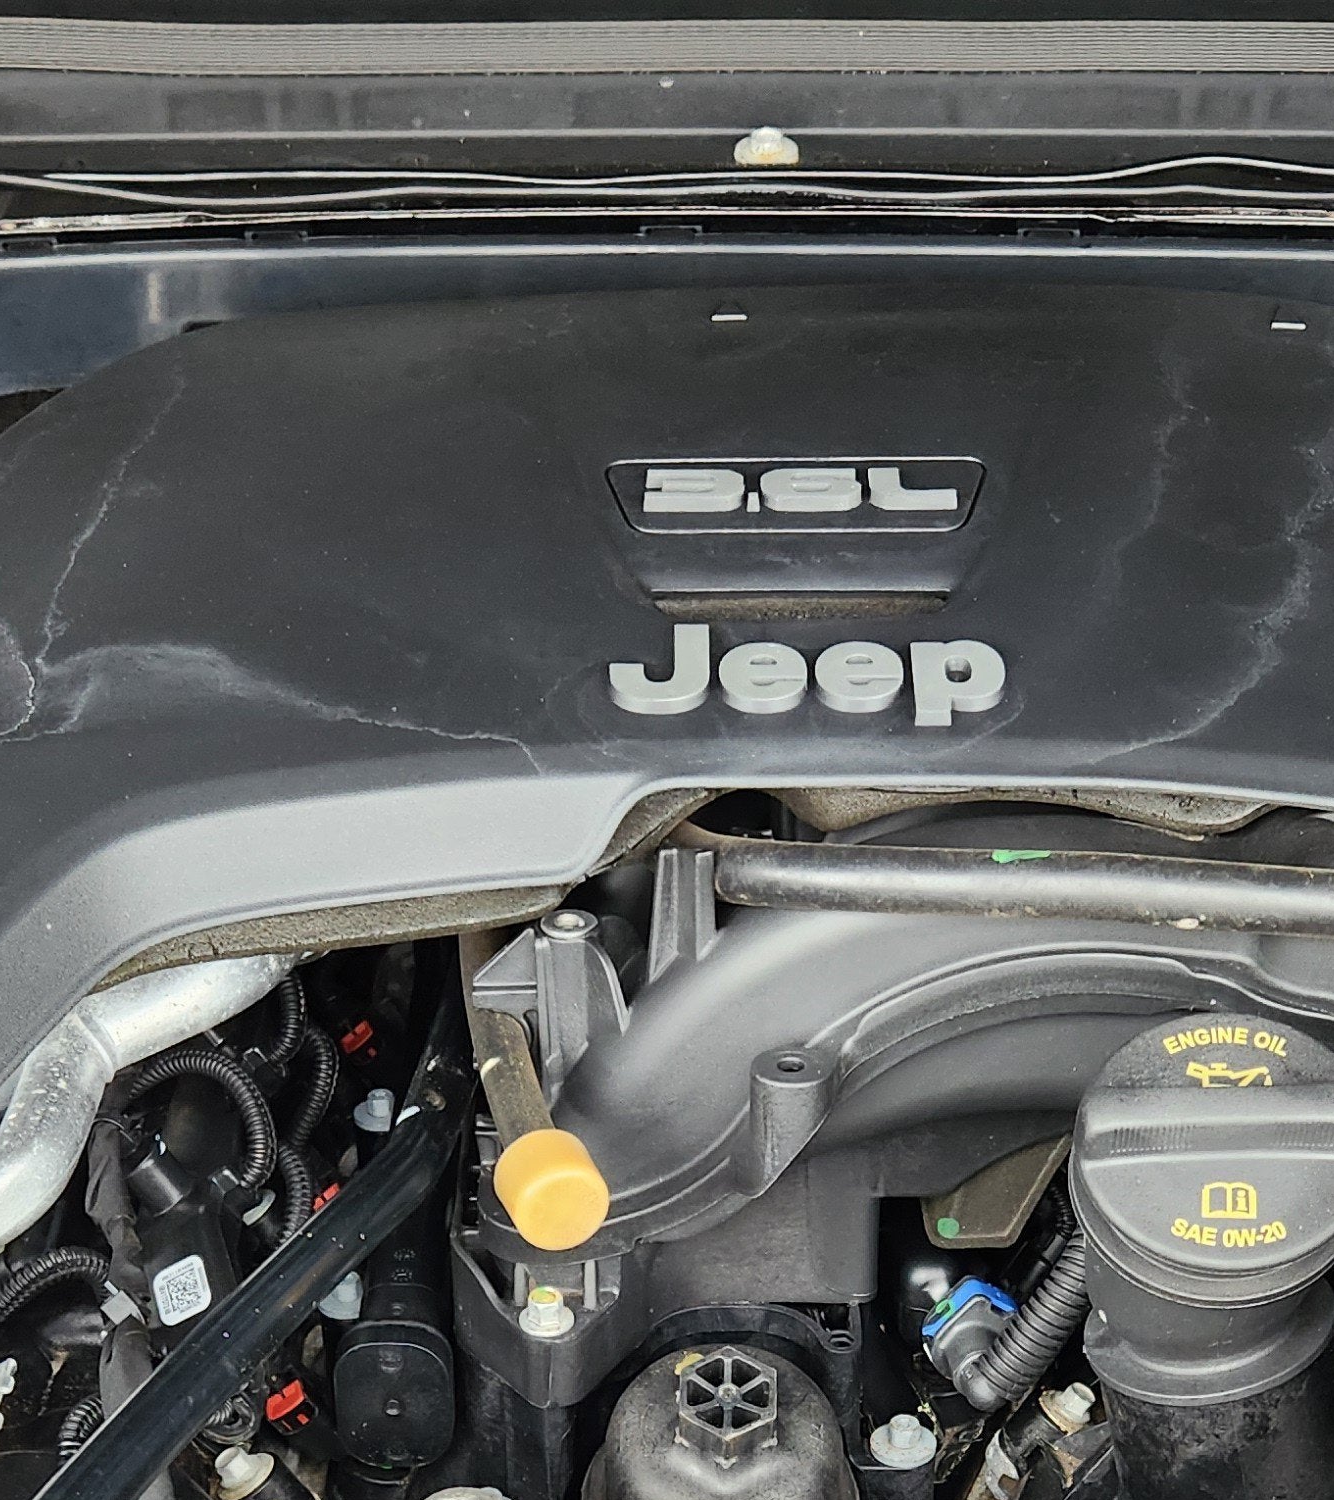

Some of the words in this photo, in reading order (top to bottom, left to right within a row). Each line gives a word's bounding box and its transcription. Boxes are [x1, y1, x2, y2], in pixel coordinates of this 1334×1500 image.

[643, 468, 957, 513] 3.6L
[609, 624, 1006, 727] Jeep
[1163, 1027, 1247, 1055] ENGINE
[1254, 1031, 1287, 1056] OIL
[1171, 1218, 1216, 1246] SAE
[1223, 1221, 1287, 1247] 0W-20
